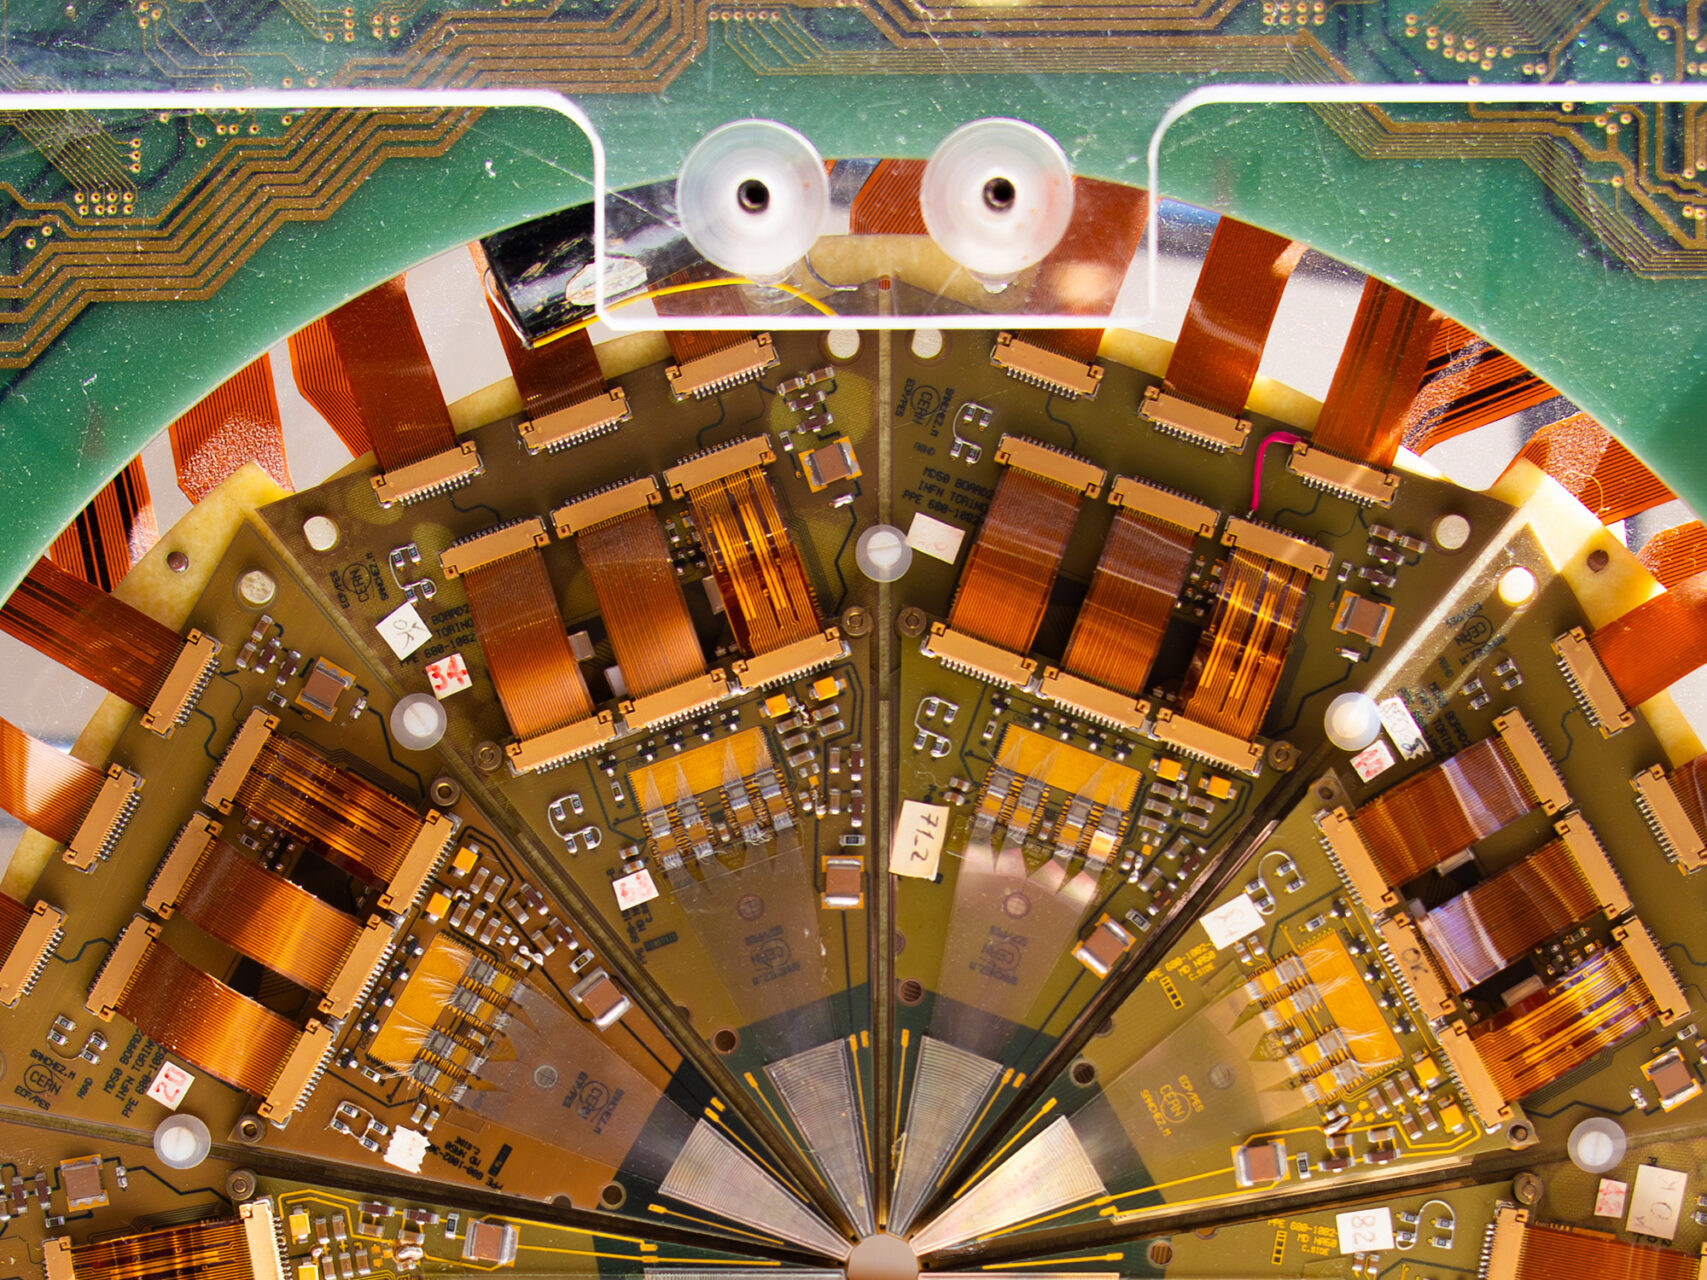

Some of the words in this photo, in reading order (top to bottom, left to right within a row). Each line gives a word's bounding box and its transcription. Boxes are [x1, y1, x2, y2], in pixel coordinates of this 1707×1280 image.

[901, 489, 923, 504] PPE
[917, 480, 944, 497] INFN
[948, 491, 989, 514] TORINO
[348, 568, 370, 603] CERN
[430, 602, 471, 625] BOARD2
[435, 617, 474, 639] TORINO
[1177, 963, 1191, 976] MD
[1398, 944, 1430, 981] OK
[28, 1069, 62, 1095] CERN
[114, 1074, 135, 1101] INFN
[153, 1064, 188, 1103] 20
[121, 1096, 139, 1118] PPE
[1160, 1083, 1185, 1116] CERN
[1296, 1233, 1309, 1242] MD
[1348, 1212, 1379, 1248] 82
